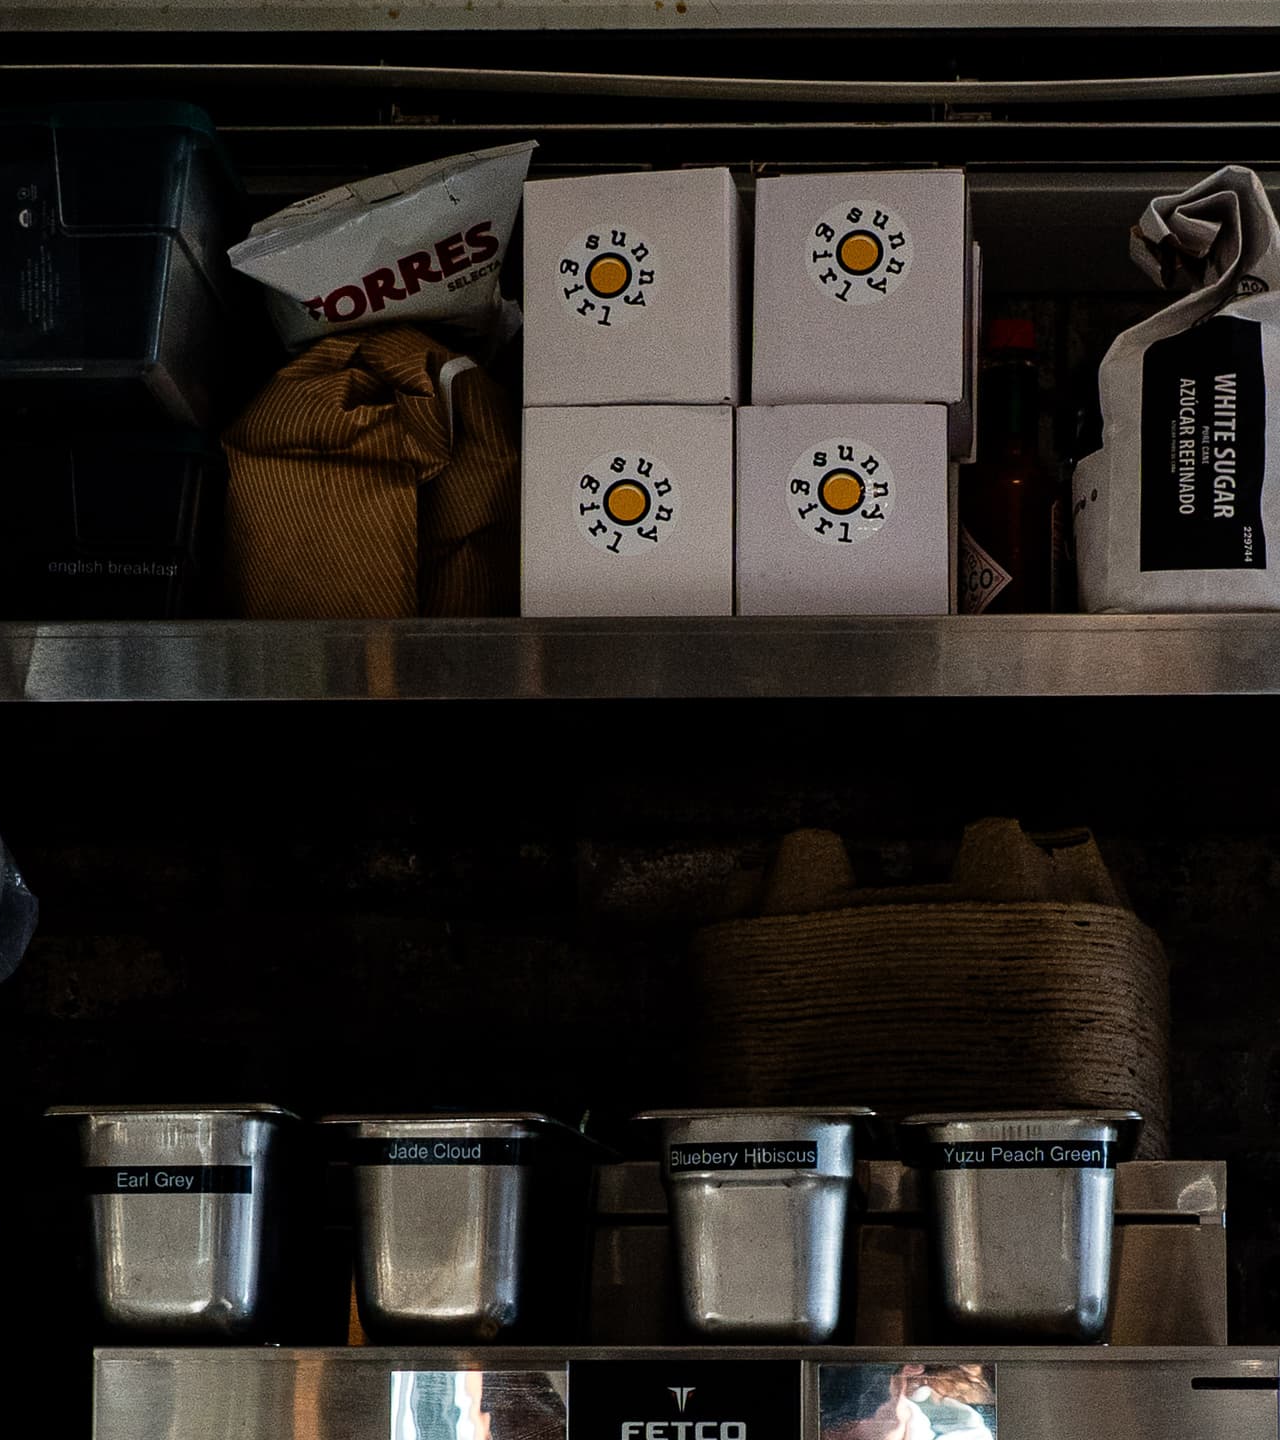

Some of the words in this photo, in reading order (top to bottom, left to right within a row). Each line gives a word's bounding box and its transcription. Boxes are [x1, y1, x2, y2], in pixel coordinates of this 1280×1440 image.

[447, 260, 501, 292] SELECTA
[586, 229, 656, 309] sunny
[812, 222, 852, 302] girl
[847, 206, 906, 295] sunny
[559, 259, 613, 327] girl
[1179, 378, 1199, 435] AZÚCAR
[1201, 425, 1210, 444] PURE
[1213, 373, 1237, 442] WHITE
[813, 444, 889, 522] sunny
[1178, 439, 1196, 515] REFINADO
[1201, 446, 1211, 465] CANE
[1212, 447, 1236, 519] SUGAR
[579, 474, 623, 553] girl
[610, 456, 674, 543] sunny
[791, 478, 852, 543] girl
[47, 561, 103, 576] english
[107, 560, 180, 576] breakfast
[1243, 525, 1253, 563] 229744
[116, 1172, 150, 1188] Earl
[154, 1172, 195, 1191] Grey
[388, 1143, 429, 1160] Jade
[433, 1143, 482, 1160] Cloud
[671, 1149, 739, 1167] Bluebery
[744, 1148, 816, 1164] Hibiscus
[944, 1149, 984, 1163] Yuzu
[990, 1147, 1045, 1162] Peach
[1050, 1146, 1101, 1162] Green
